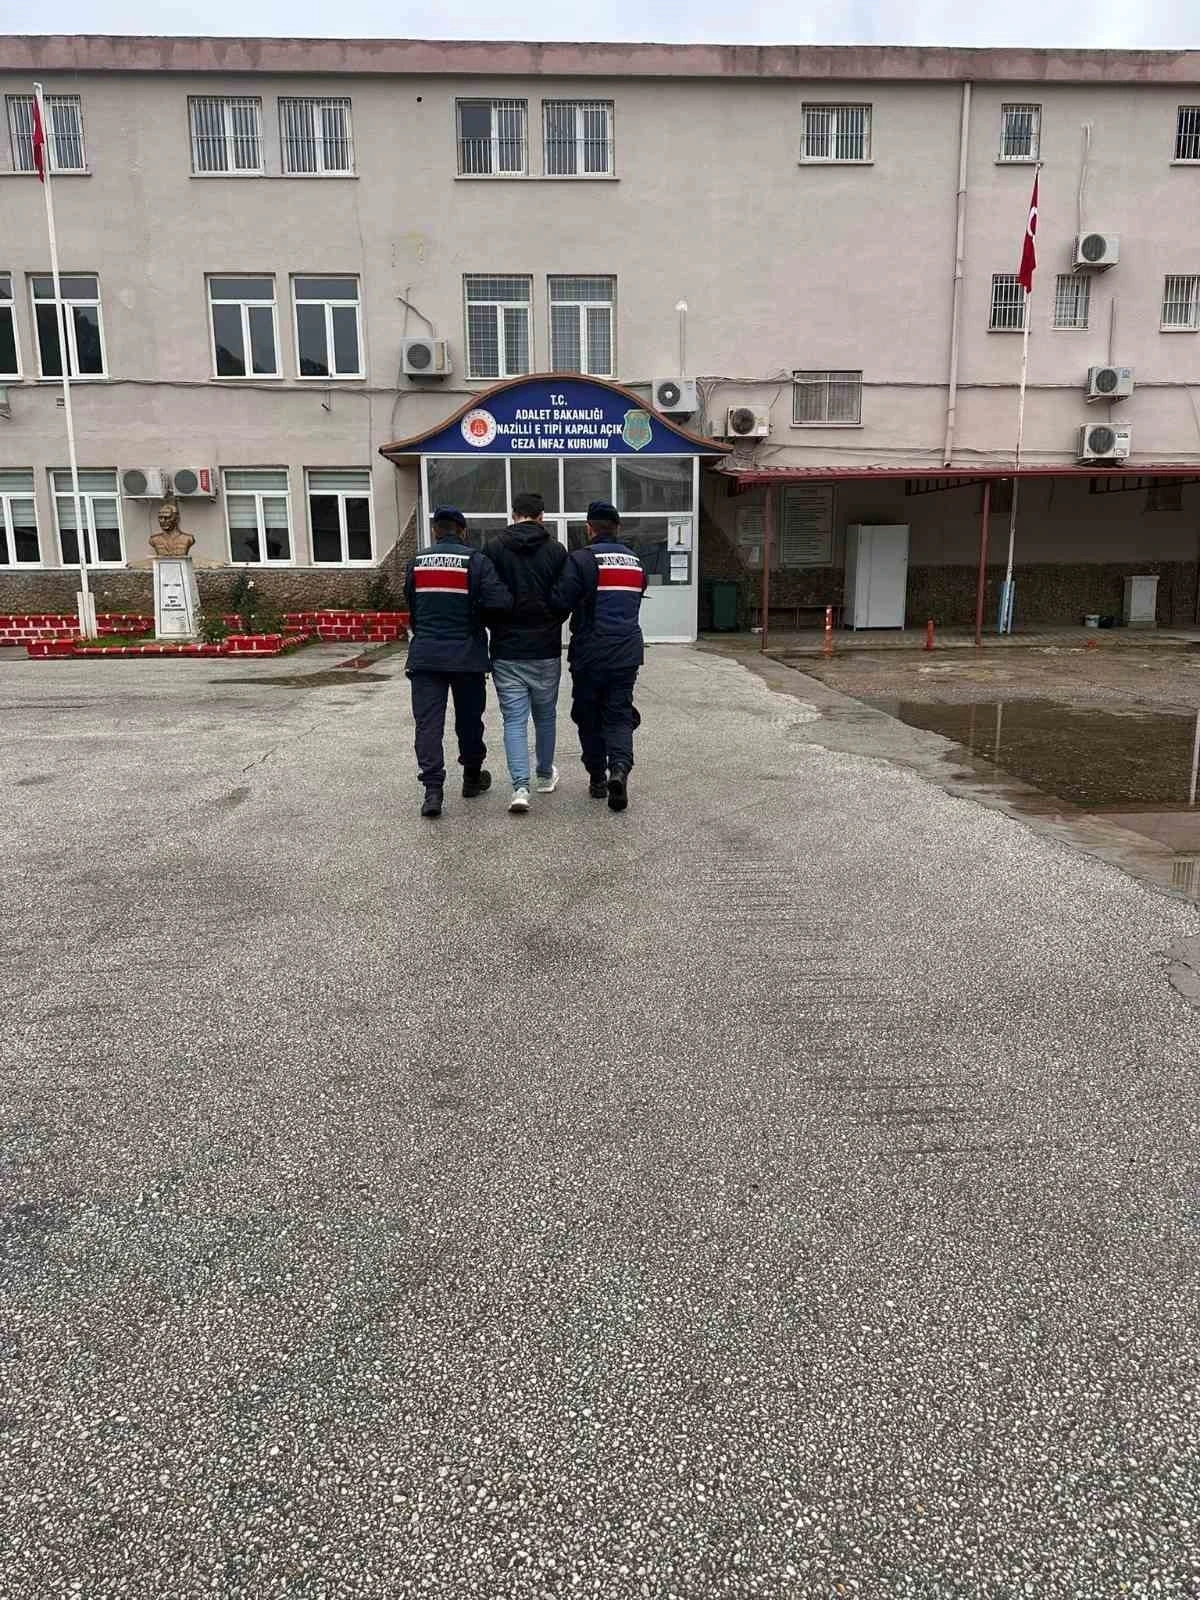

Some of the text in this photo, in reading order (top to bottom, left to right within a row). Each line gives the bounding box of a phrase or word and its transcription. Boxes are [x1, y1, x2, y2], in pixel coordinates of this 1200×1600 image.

[550, 394, 568, 406] T.C.
[515, 407, 603, 420] ADALET BAKANLIĞI
[496, 422, 532, 435] NAZİLLİ
[534, 423, 541, 434] E
[565, 423, 598, 435] KAPALI
[600, 423, 623, 437] AÇIK
[511, 436, 609, 449] CEZA İNFAZ KURUMU
[418, 557, 463, 568] JANDARMA
